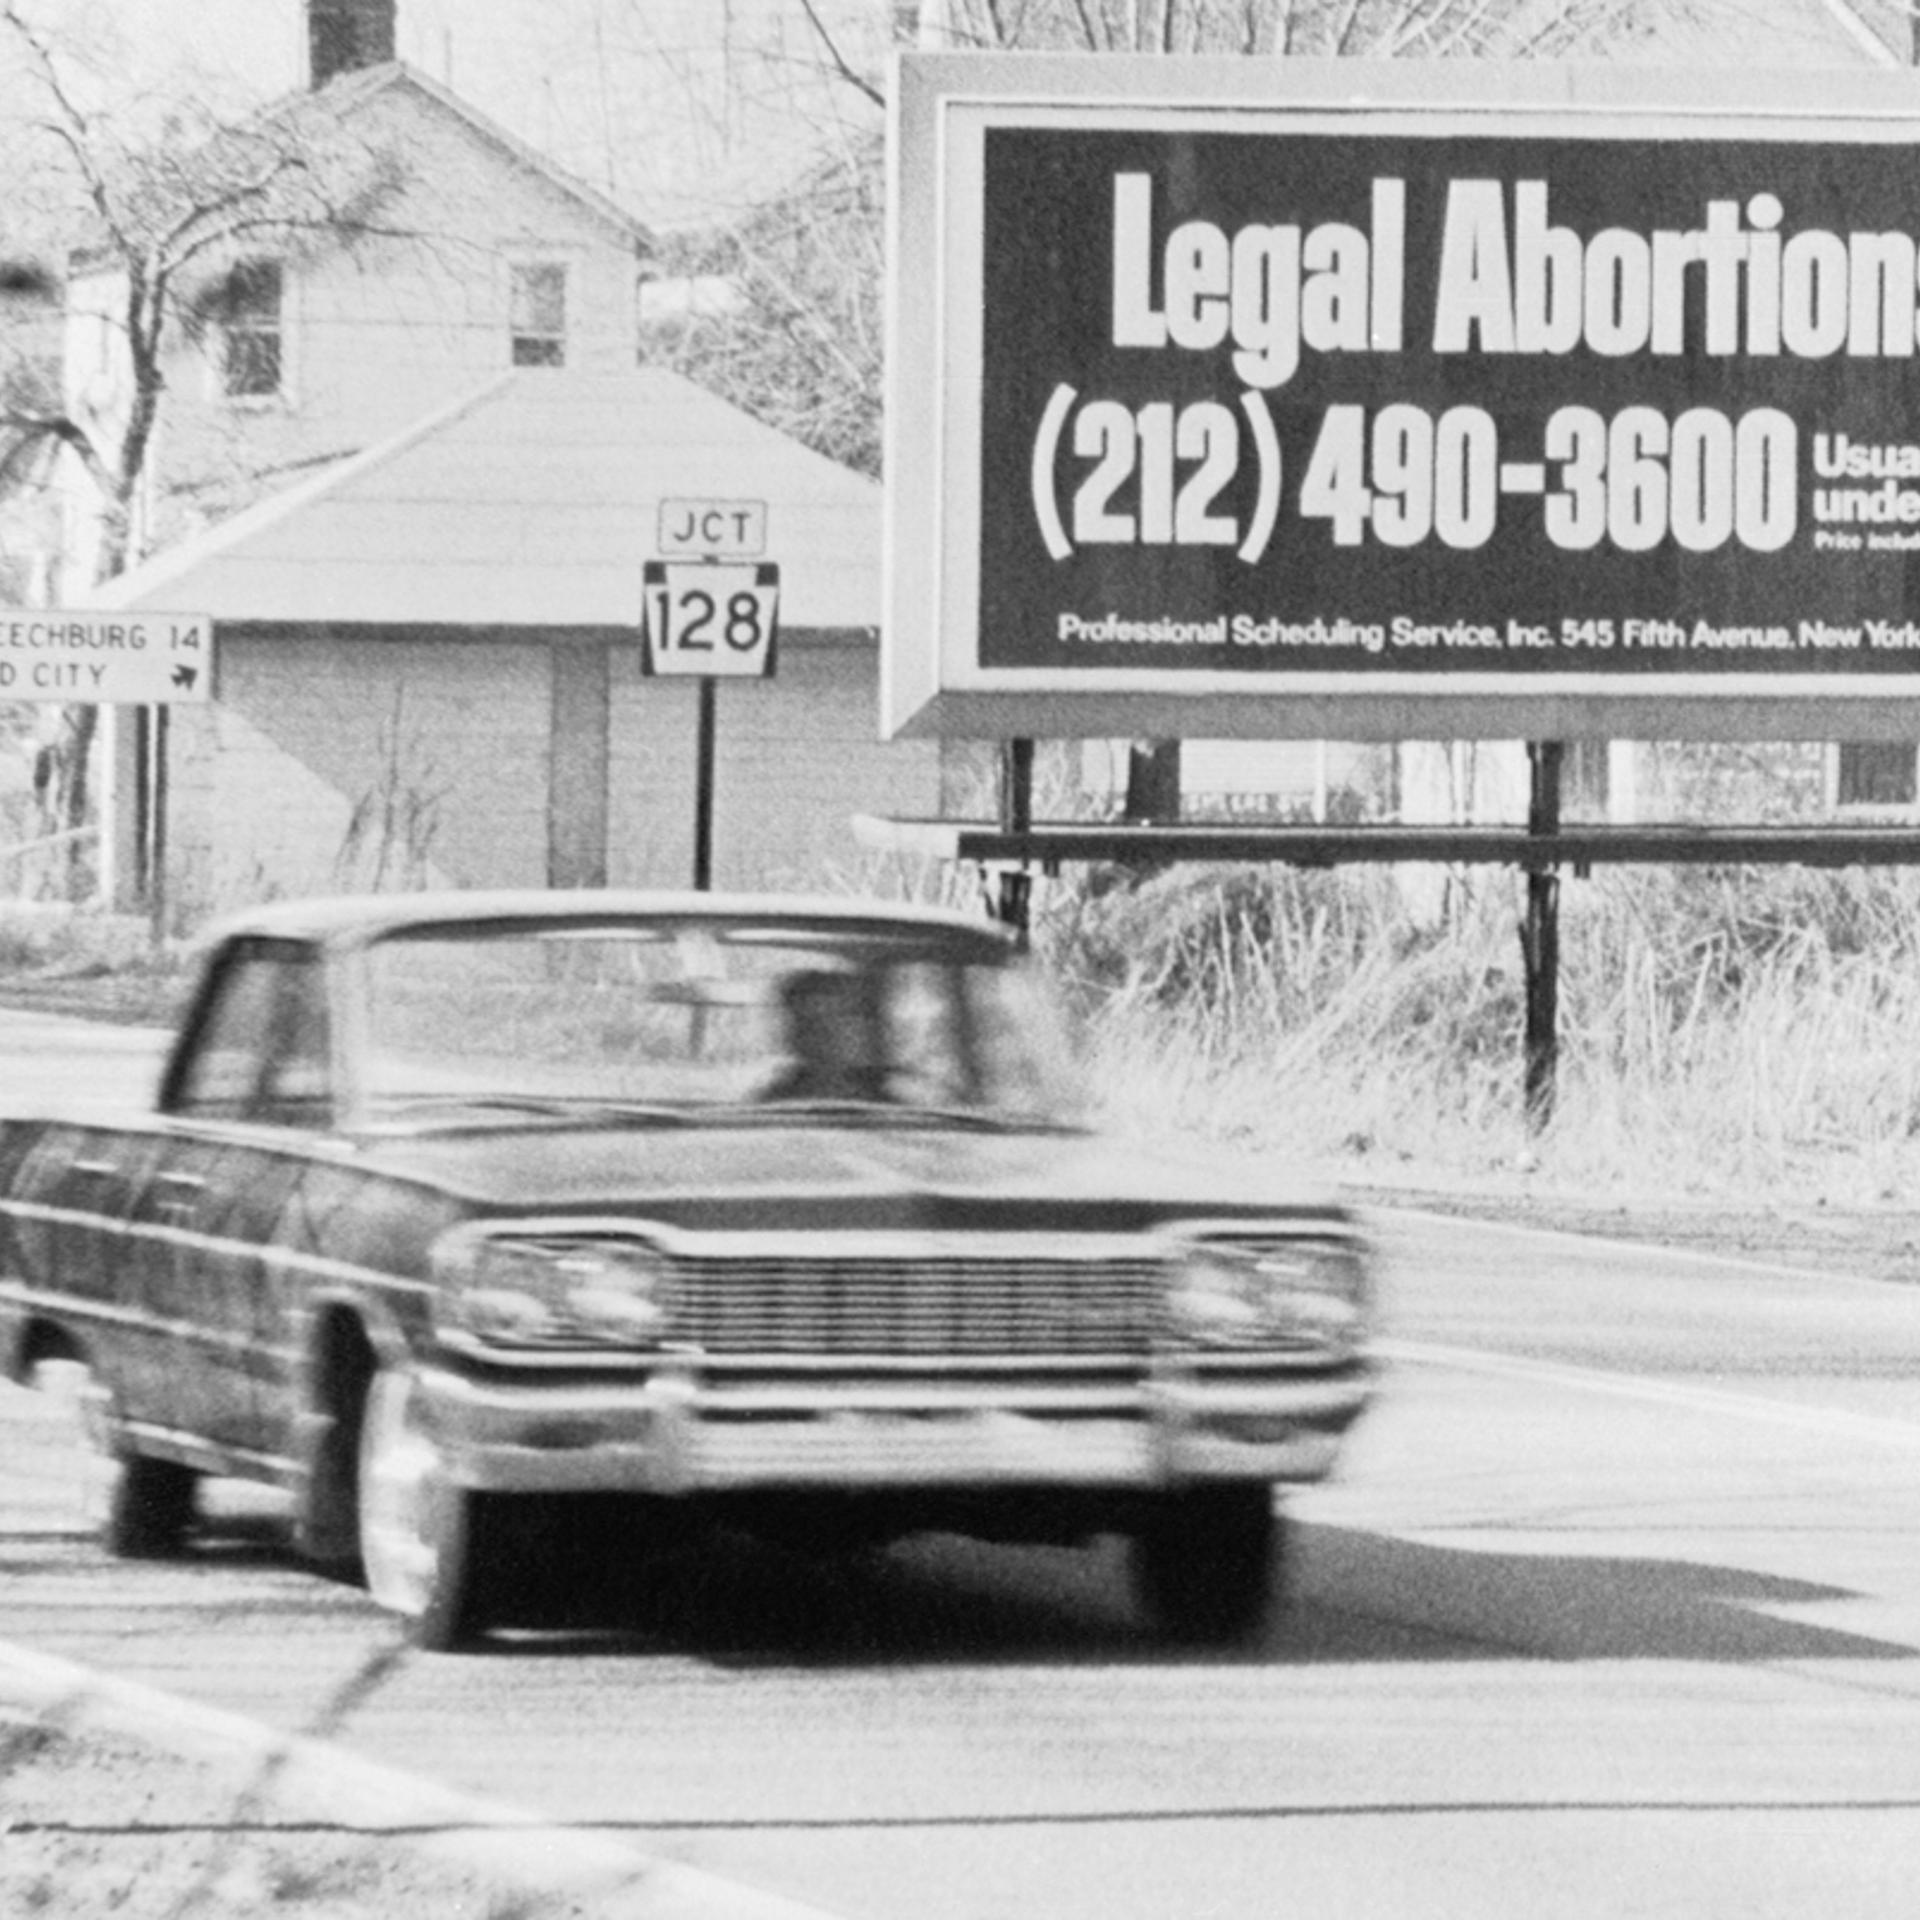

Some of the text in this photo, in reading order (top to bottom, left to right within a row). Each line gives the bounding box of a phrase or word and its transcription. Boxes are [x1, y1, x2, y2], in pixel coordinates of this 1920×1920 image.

[1112, 172, 1920, 389] Legal Abortion
[1031, 382, 1798, 564] (212) 490-3600
[673, 510, 751, 543] JCT
[170, 625, 200, 650] 14
[656, 589, 761, 652] 128
[1058, 612, 1227, 644] Professional
[1231, 614, 1385, 653] Scheduling
[1507, 619, 1556, 648] Inc.
[1561, 618, 1615, 648] 545
[1622, 618, 1686, 648] Fifth
[1798, 620, 1862, 648] New
[33, 662, 106, 687] CITY
